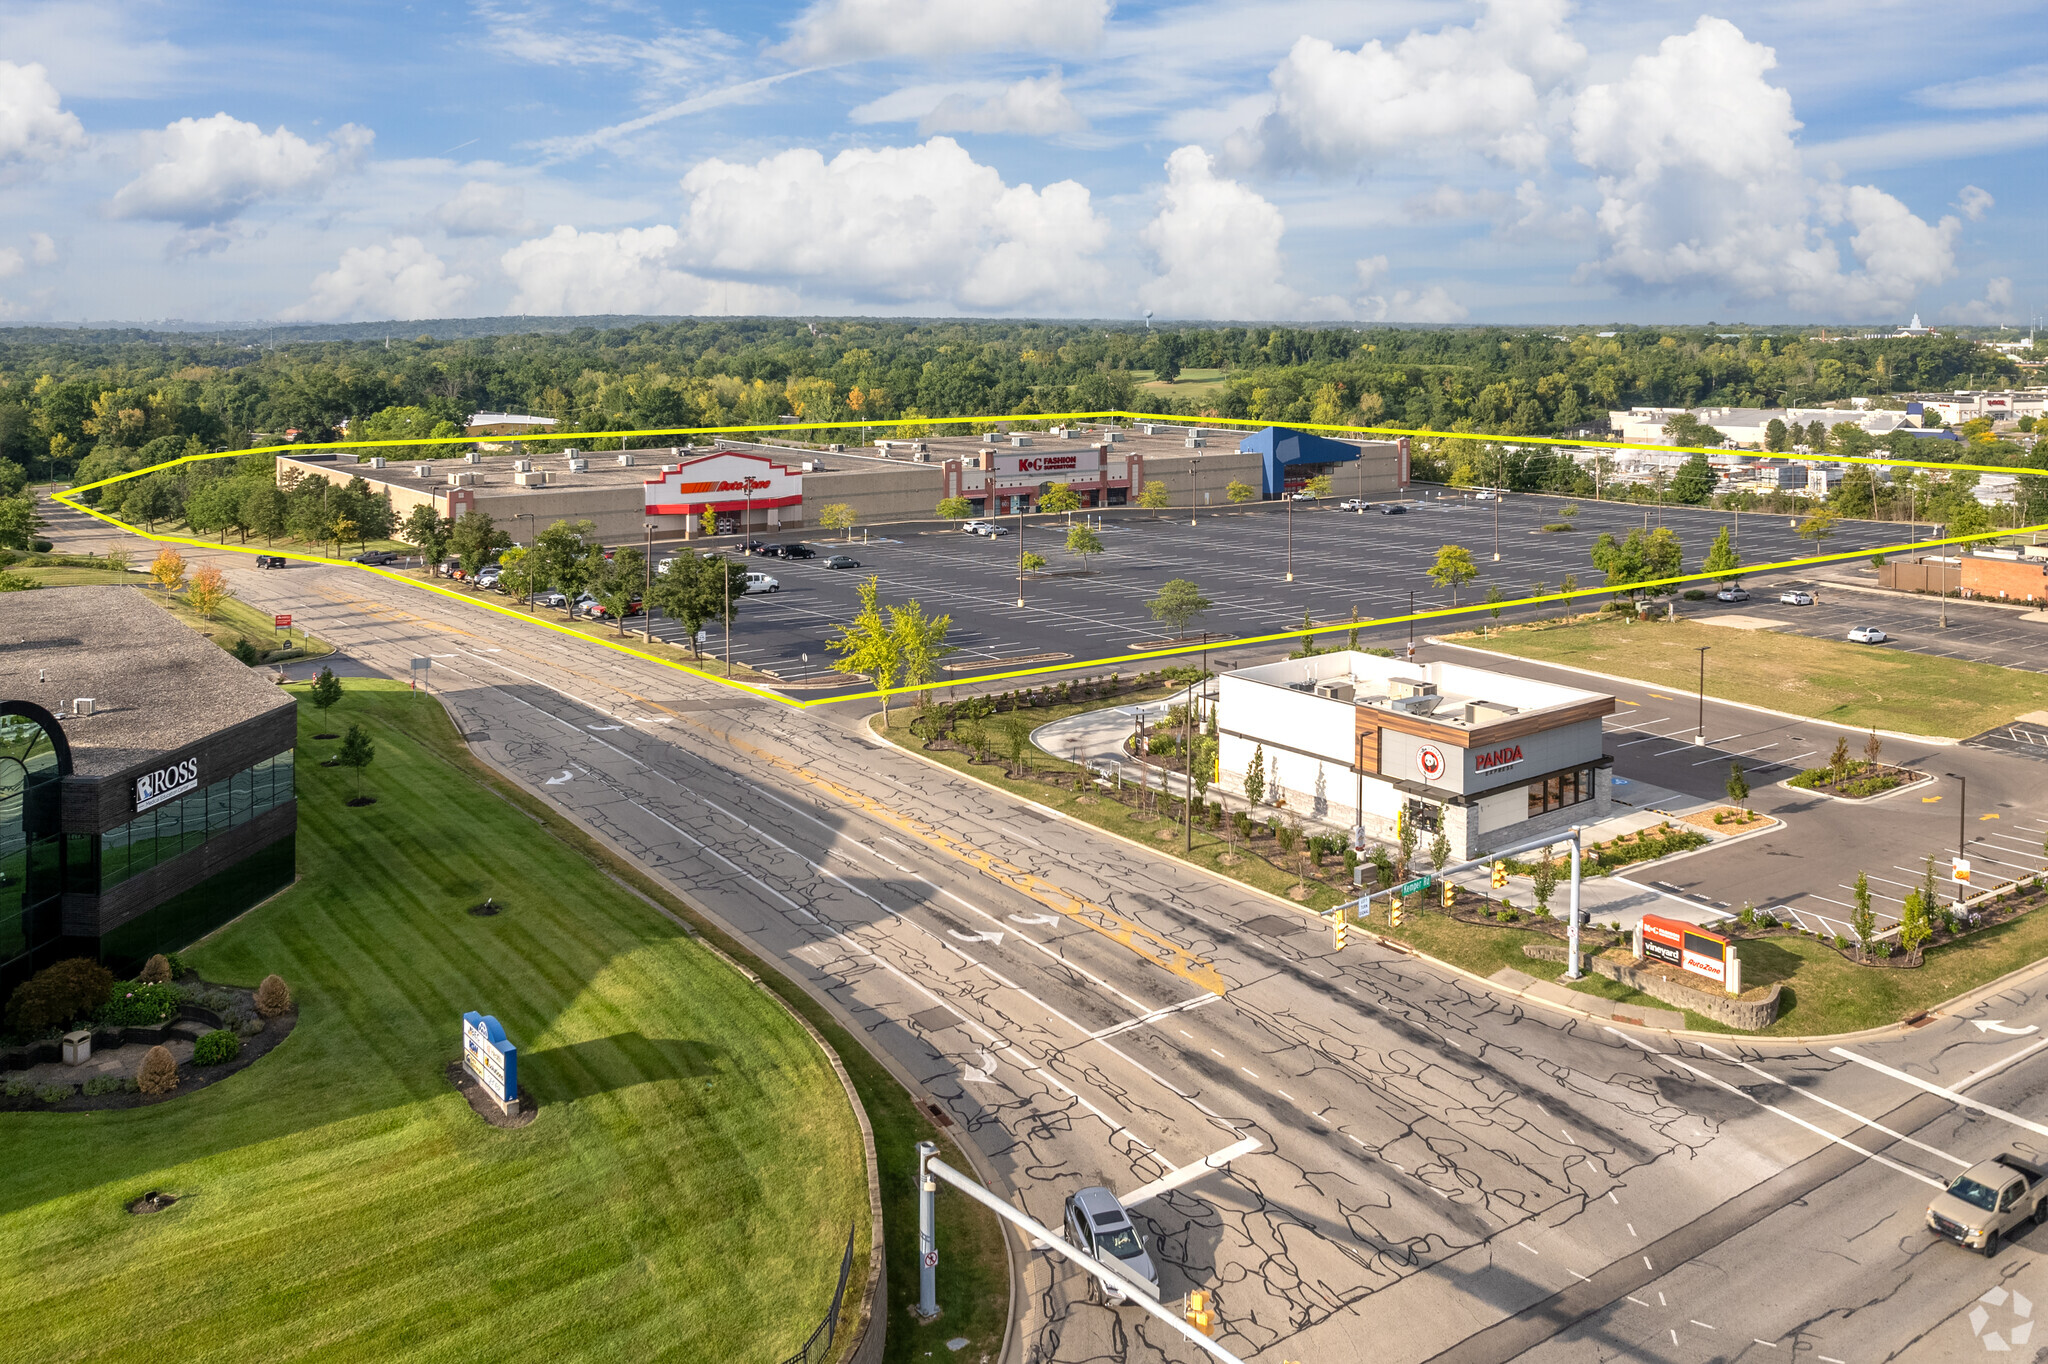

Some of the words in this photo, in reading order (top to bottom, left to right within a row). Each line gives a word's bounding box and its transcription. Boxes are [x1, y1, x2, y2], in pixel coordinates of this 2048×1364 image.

[1043, 455, 1077, 465] FASHION
[717, 478, 771, 492] AutoZone
[1475, 744, 1524, 771] PANDA
[153, 757, 198, 796] ROSS
[1485, 764, 1514, 777] EXPRESS
[1403, 880, 1422, 894] Kemper
[1423, 876, 1430, 887] Rd
[1645, 942, 1679, 959] vineyard
[1688, 959, 1721, 974] AutoZone
